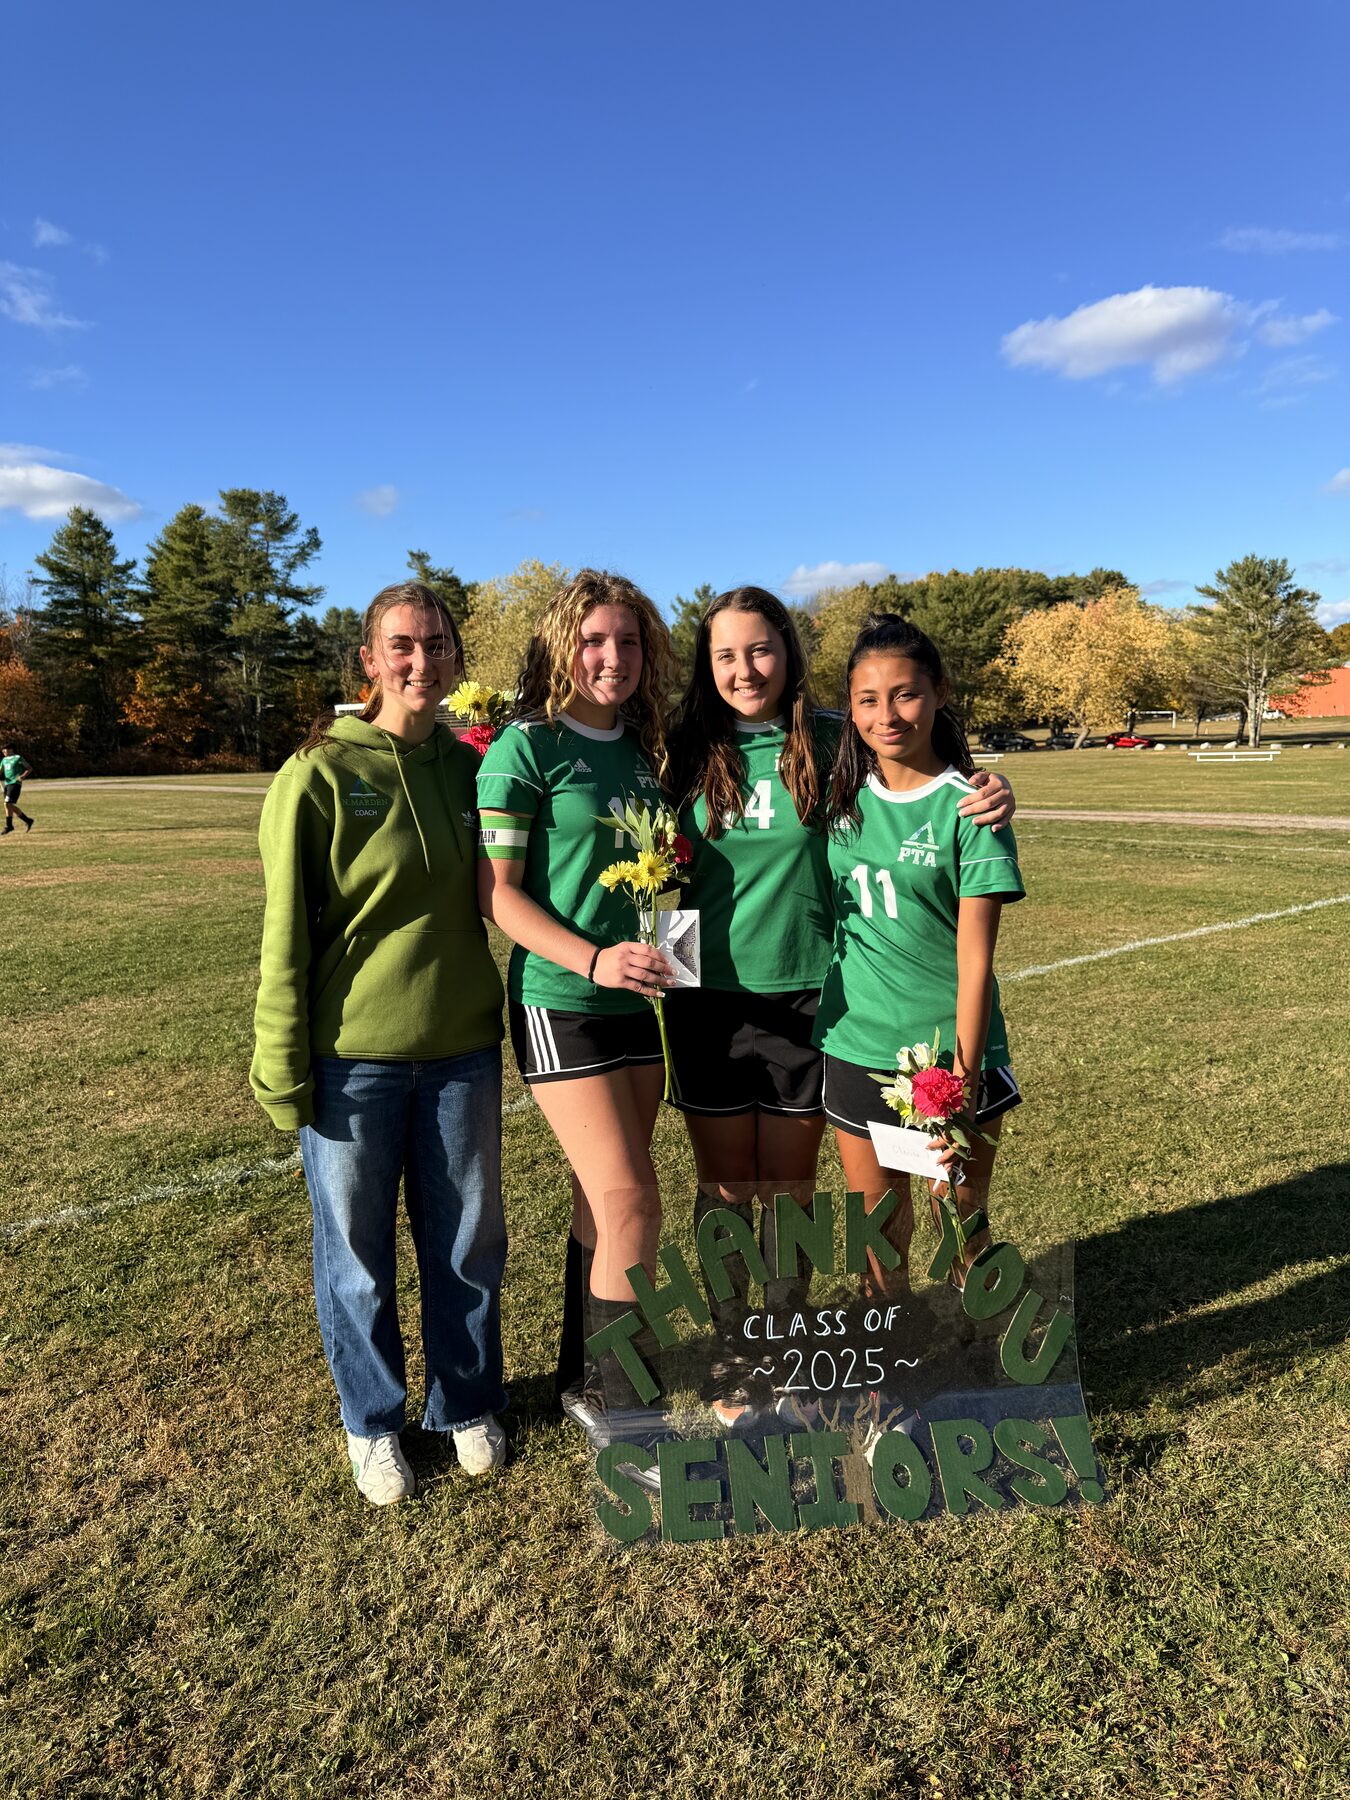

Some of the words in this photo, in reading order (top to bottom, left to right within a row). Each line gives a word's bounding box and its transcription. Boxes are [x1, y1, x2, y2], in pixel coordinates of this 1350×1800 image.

[354, 809, 378, 817] COACH
[722, 779, 776, 830] 4
[897, 846, 937, 868] PTA
[850, 864, 898, 919] 11
[585, 1188, 901, 1406] THANK
[926, 1196, 1075, 1386] YOU
[743, 1310, 847, 1340] CLASS
[863, 1305, 902, 1332] OF
[595, 1415, 1104, 1543] SENIORS!
